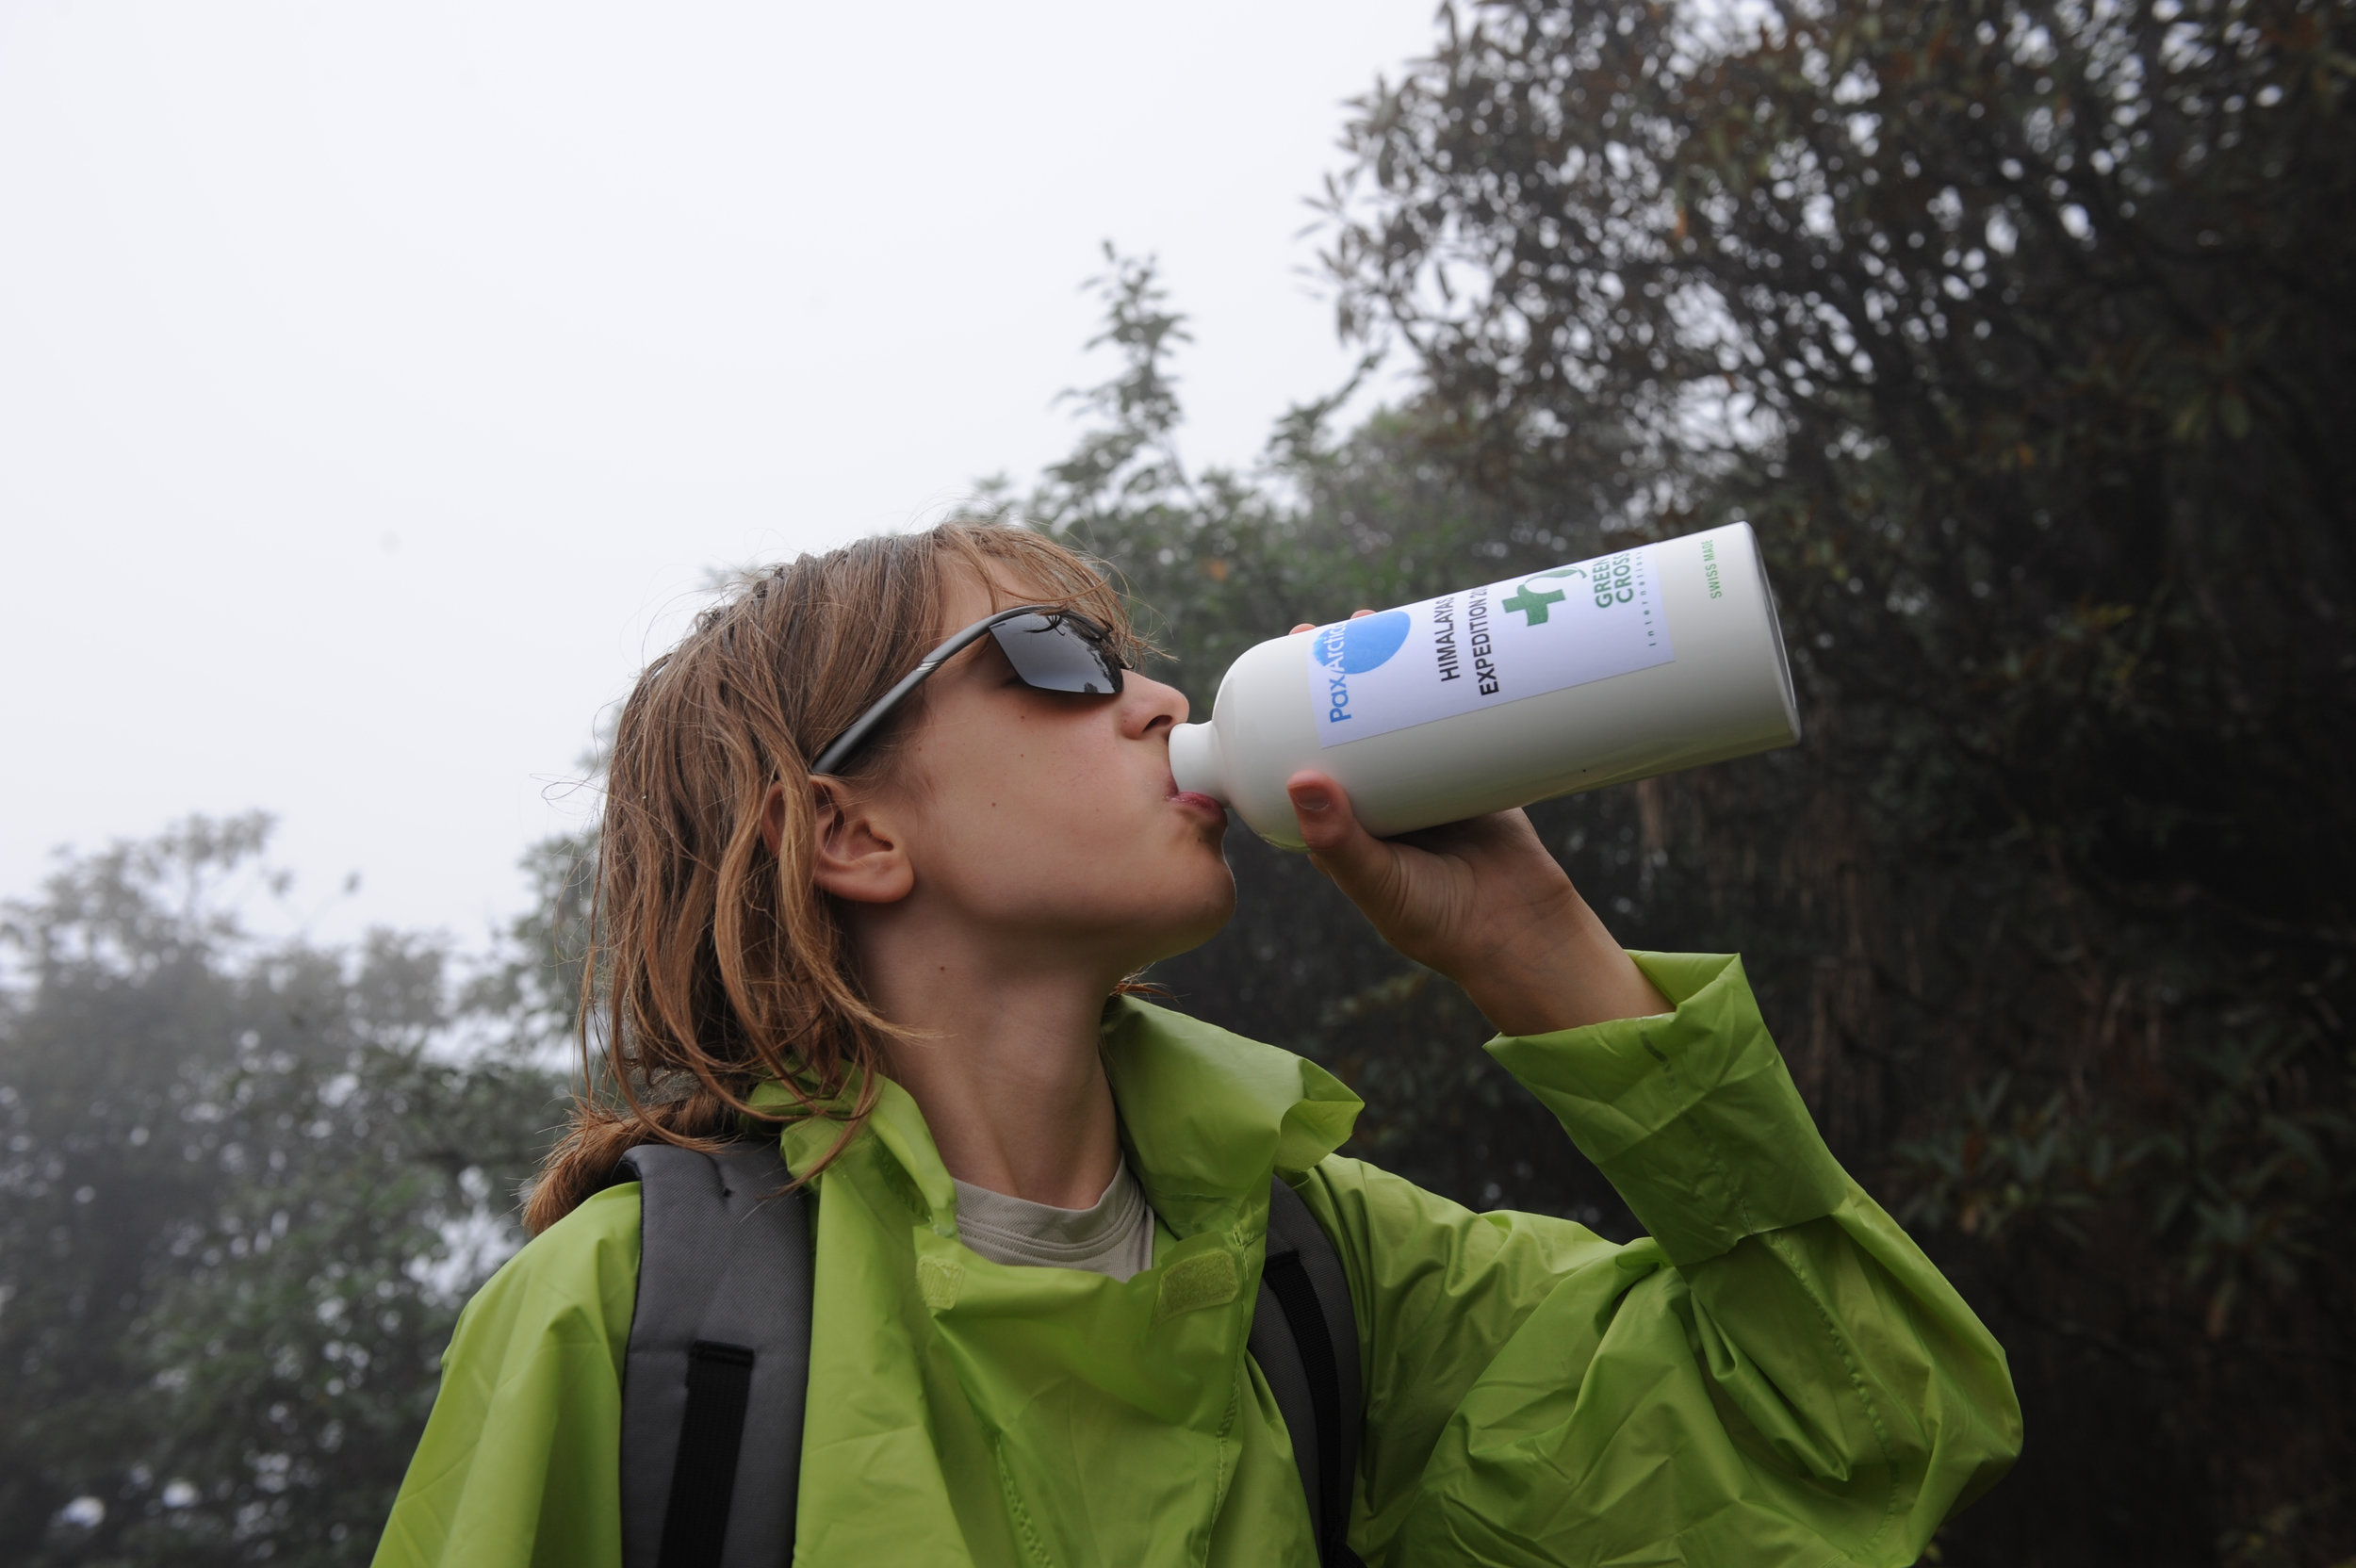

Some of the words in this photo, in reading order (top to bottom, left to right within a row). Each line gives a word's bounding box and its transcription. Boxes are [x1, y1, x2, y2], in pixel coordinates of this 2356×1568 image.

[1701, 539, 1715, 562] MADE
[1592, 557, 1613, 609] GREEN
[1612, 552, 1634, 603] CROSS
[1705, 564, 1723, 599] SWISS
[1433, 596, 1460, 681] HIMALAYAS
[1468, 597, 1499, 695] EXPEDITION
